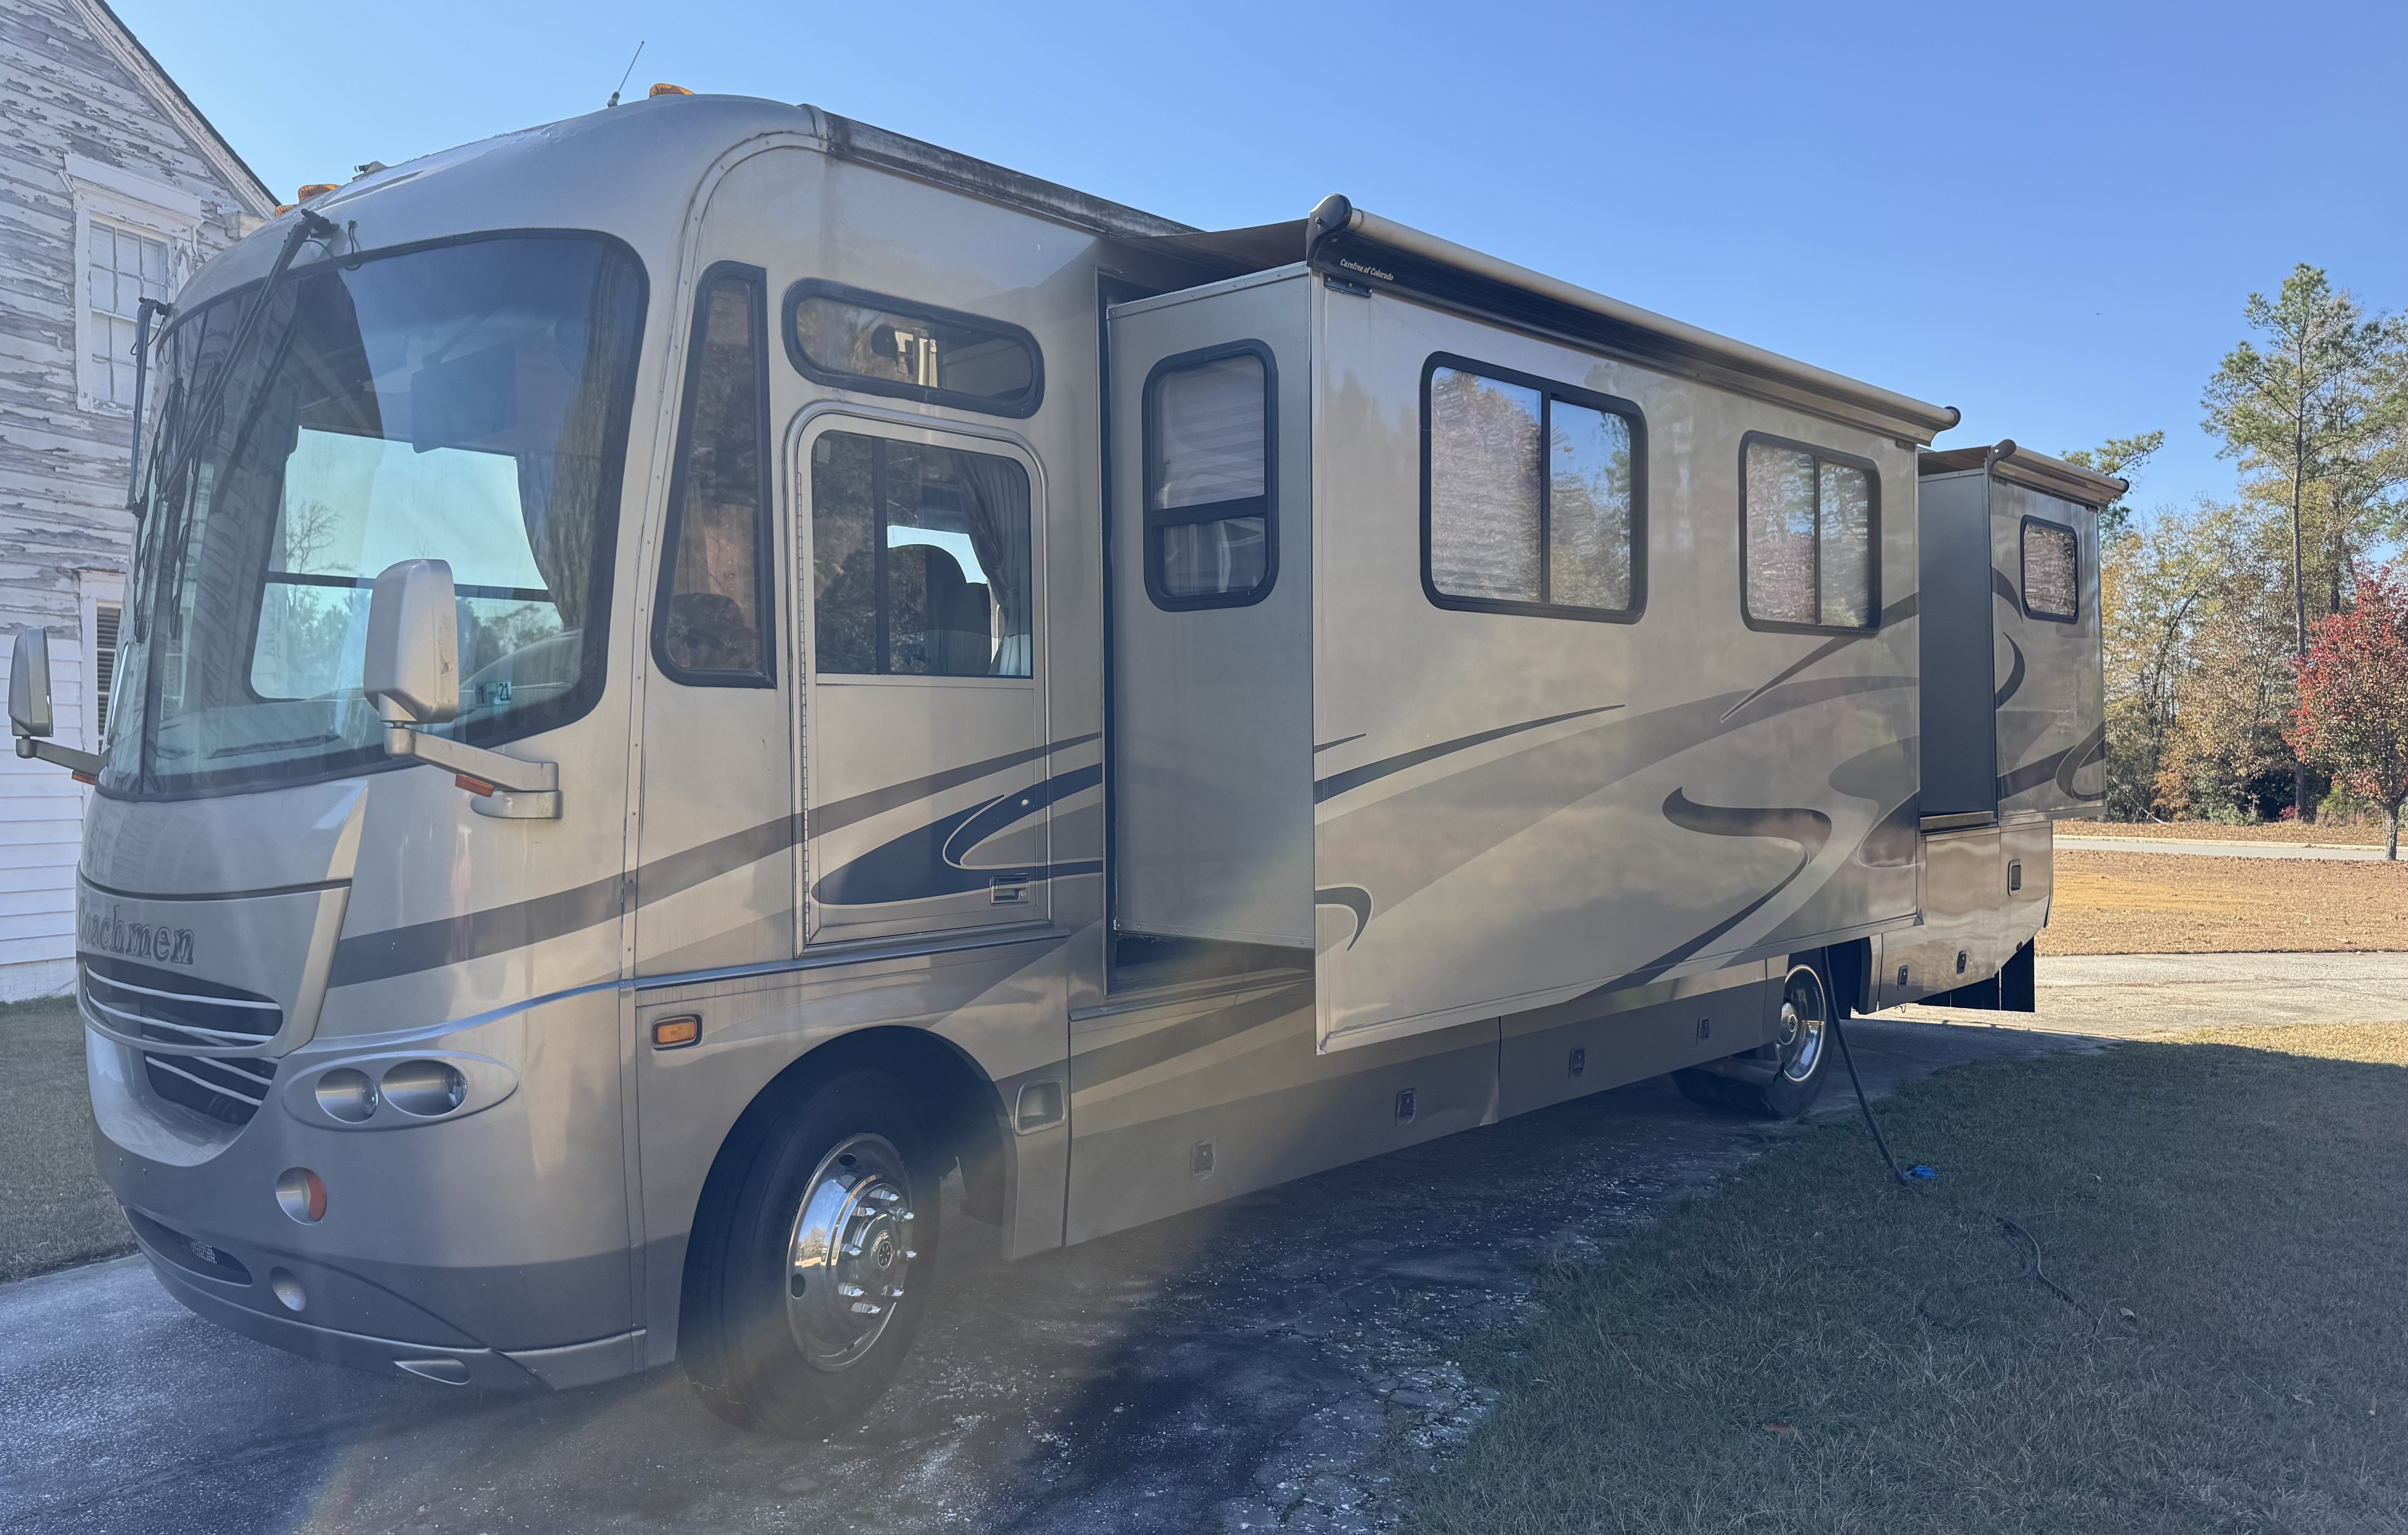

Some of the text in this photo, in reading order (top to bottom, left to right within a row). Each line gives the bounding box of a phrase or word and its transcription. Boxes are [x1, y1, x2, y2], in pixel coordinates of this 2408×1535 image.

[1340, 259, 1364, 273] Carefree
[1370, 268, 1394, 281] Colorado
[499, 683, 511, 701] 21
